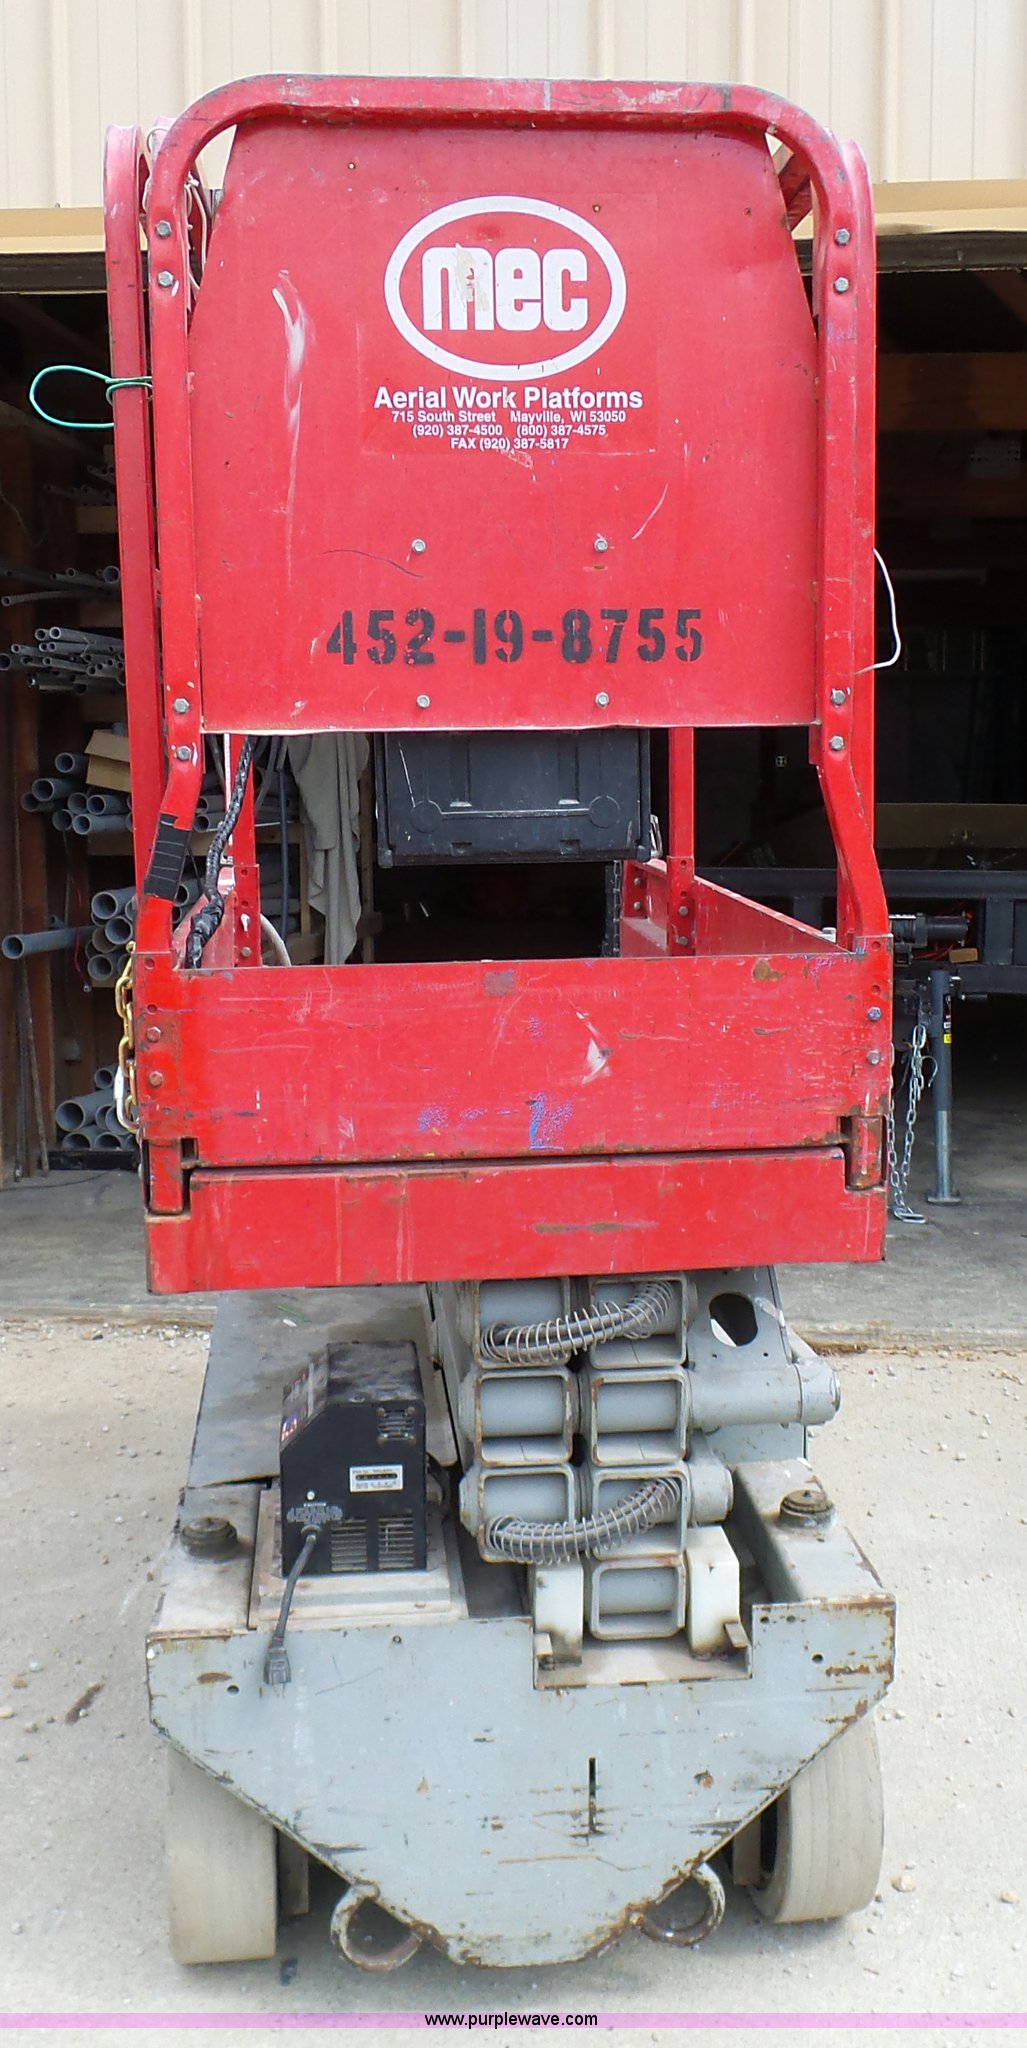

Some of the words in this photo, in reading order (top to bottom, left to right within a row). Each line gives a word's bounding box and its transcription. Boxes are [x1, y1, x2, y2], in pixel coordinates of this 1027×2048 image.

[421, 246, 588, 332] mec
[373, 386, 447, 409] Aerial
[452, 386, 517, 409] Work
[524, 386, 643, 409] Platforms
[392, 410, 414, 423] 715
[417, 410, 455, 423] South
[458, 410, 496, 423] Street
[510, 410, 565, 425] Mayville,
[570, 410, 587, 423] WI
[589, 410, 626, 423] 53050
[412, 424, 444, 438] (920)
[447, 424, 503, 436] 387-4500
[516, 424, 547, 438] (800)
[551, 424, 606, 436] 387-4575
[450, 437, 476, 449] FAX
[479, 437, 511, 451] (920)
[513, 437, 569, 449] 387-5817
[326, 607, 703, 665] 452-19-8755
